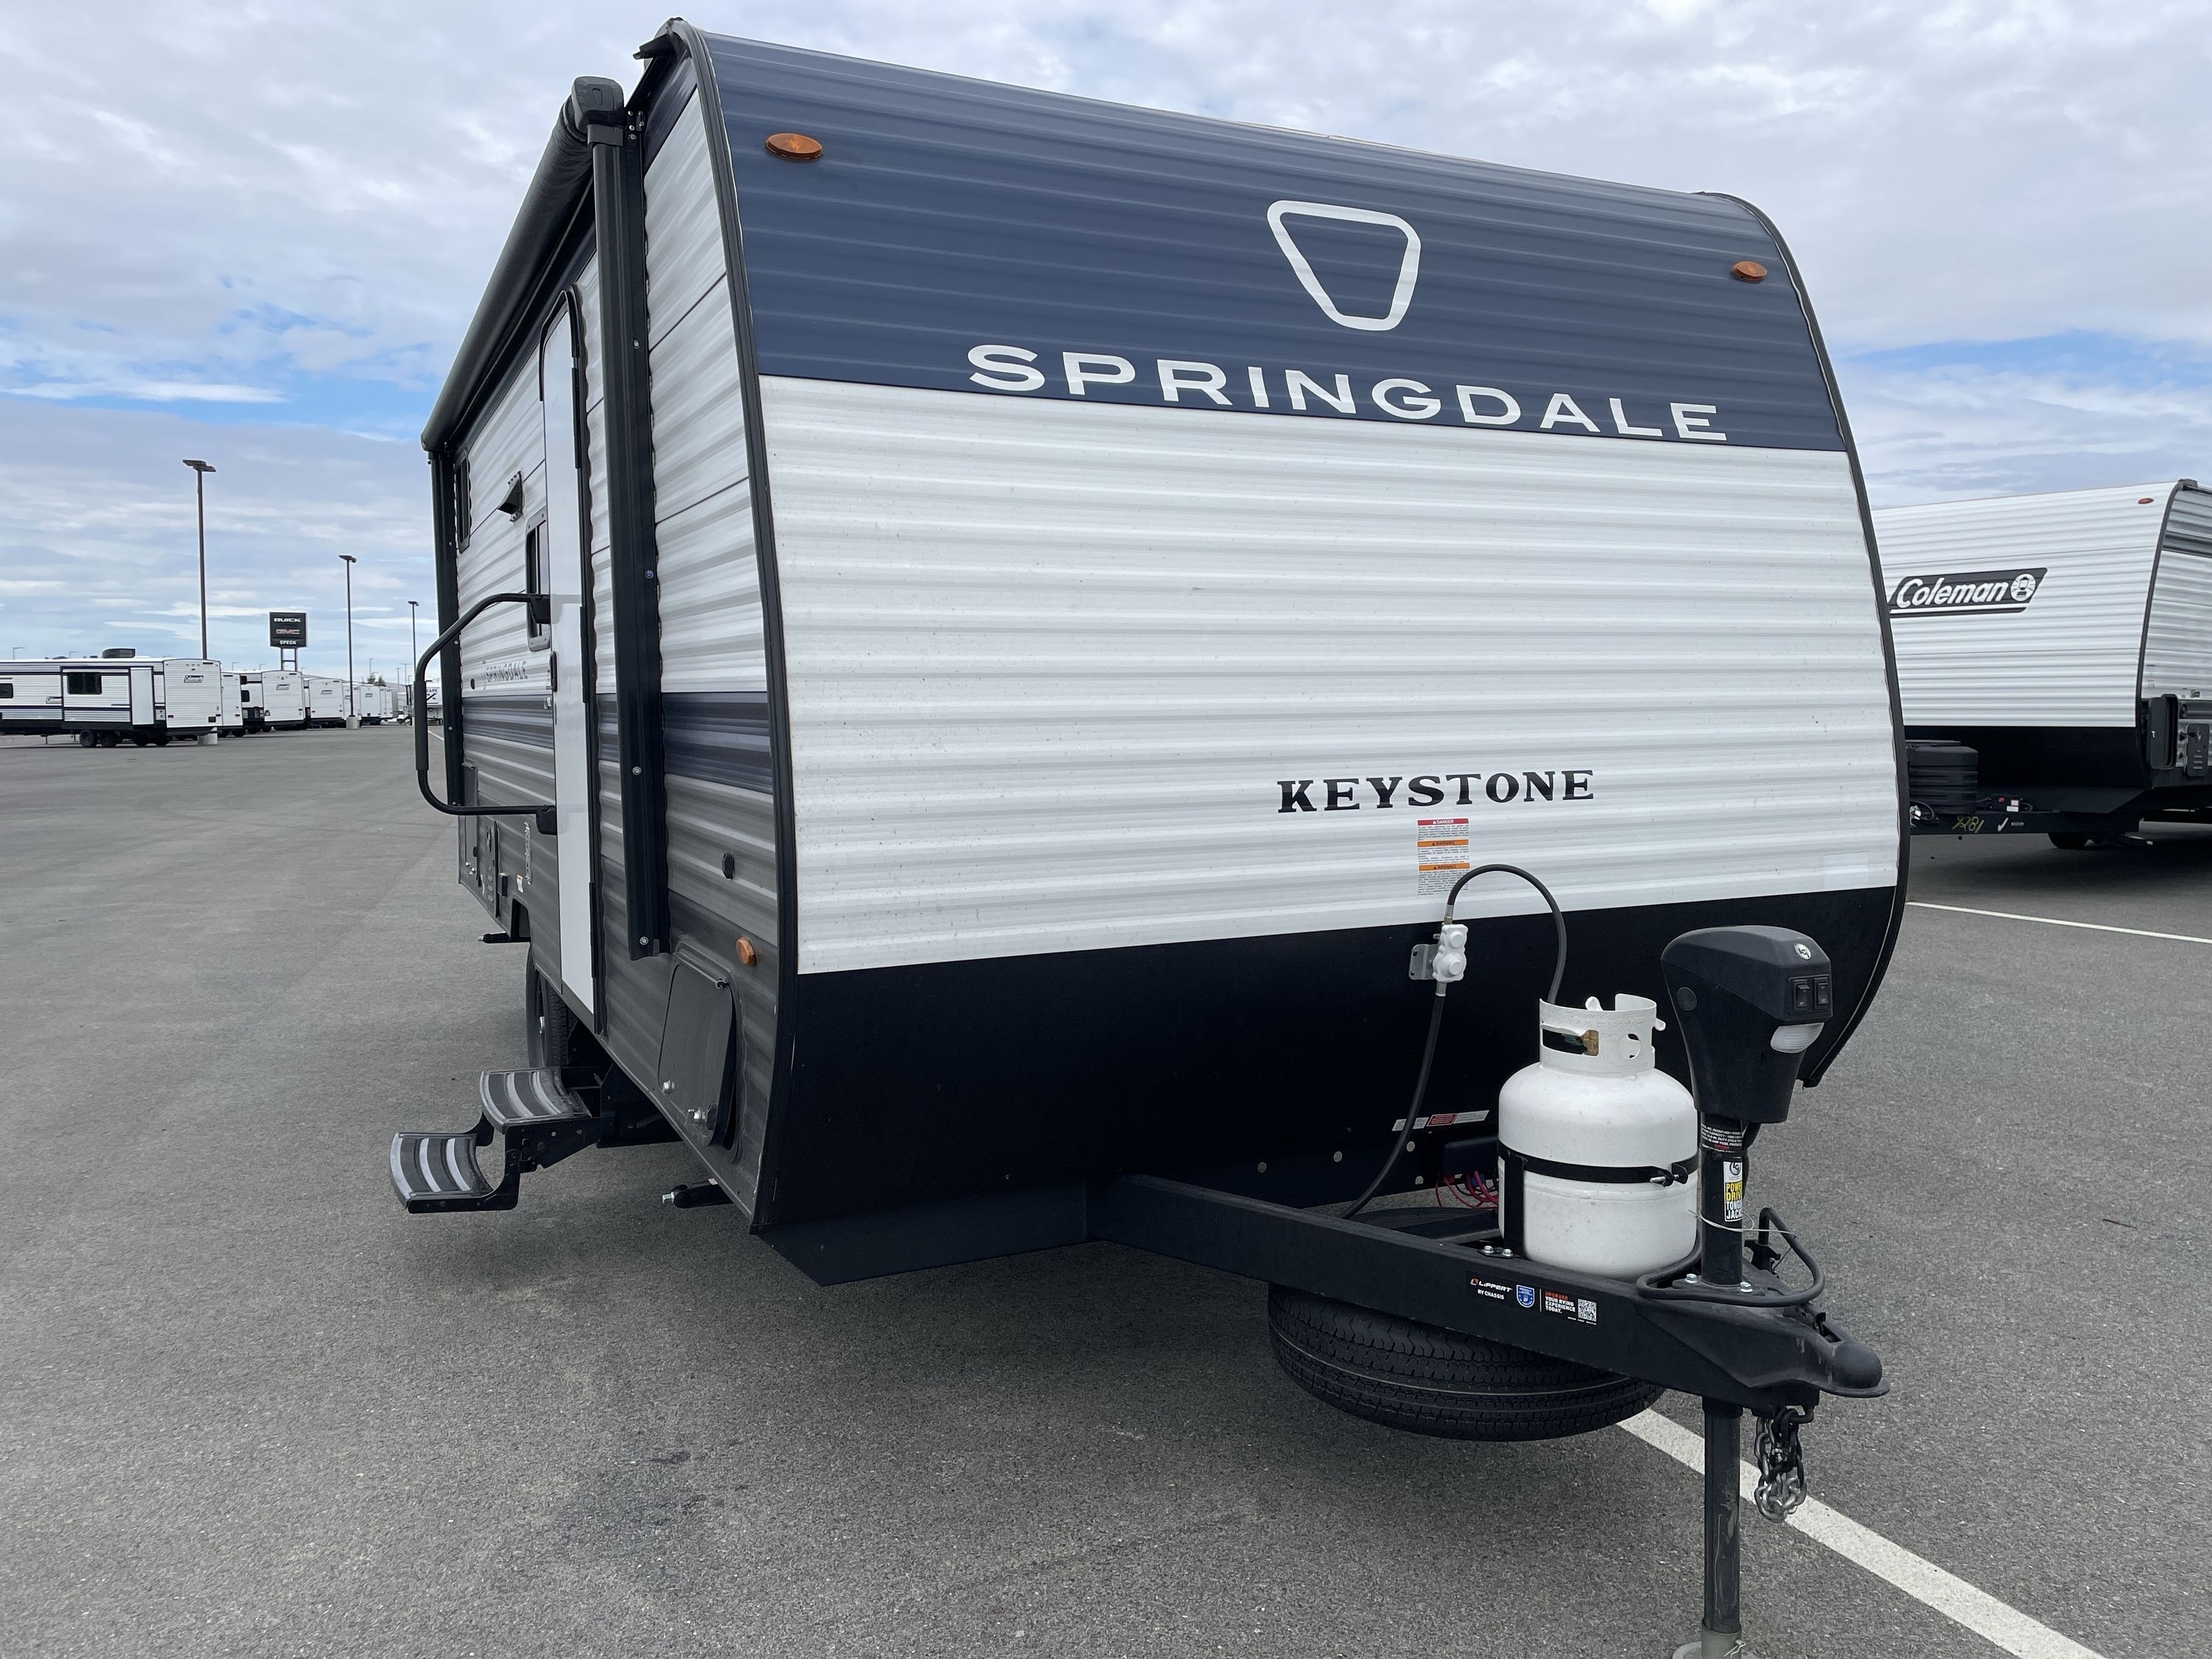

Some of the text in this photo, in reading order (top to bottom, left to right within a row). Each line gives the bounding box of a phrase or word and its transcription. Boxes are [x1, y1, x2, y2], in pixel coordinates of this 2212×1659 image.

[967, 344, 1727, 442] SPRINGDALE
[1896, 577, 2009, 608] Coleman
[1277, 769, 1594, 813] KEYSTONE
[1484, 1290, 1504, 1300] CHASSIS
[1545, 1301, 1576, 1312] EXPERIENCE
